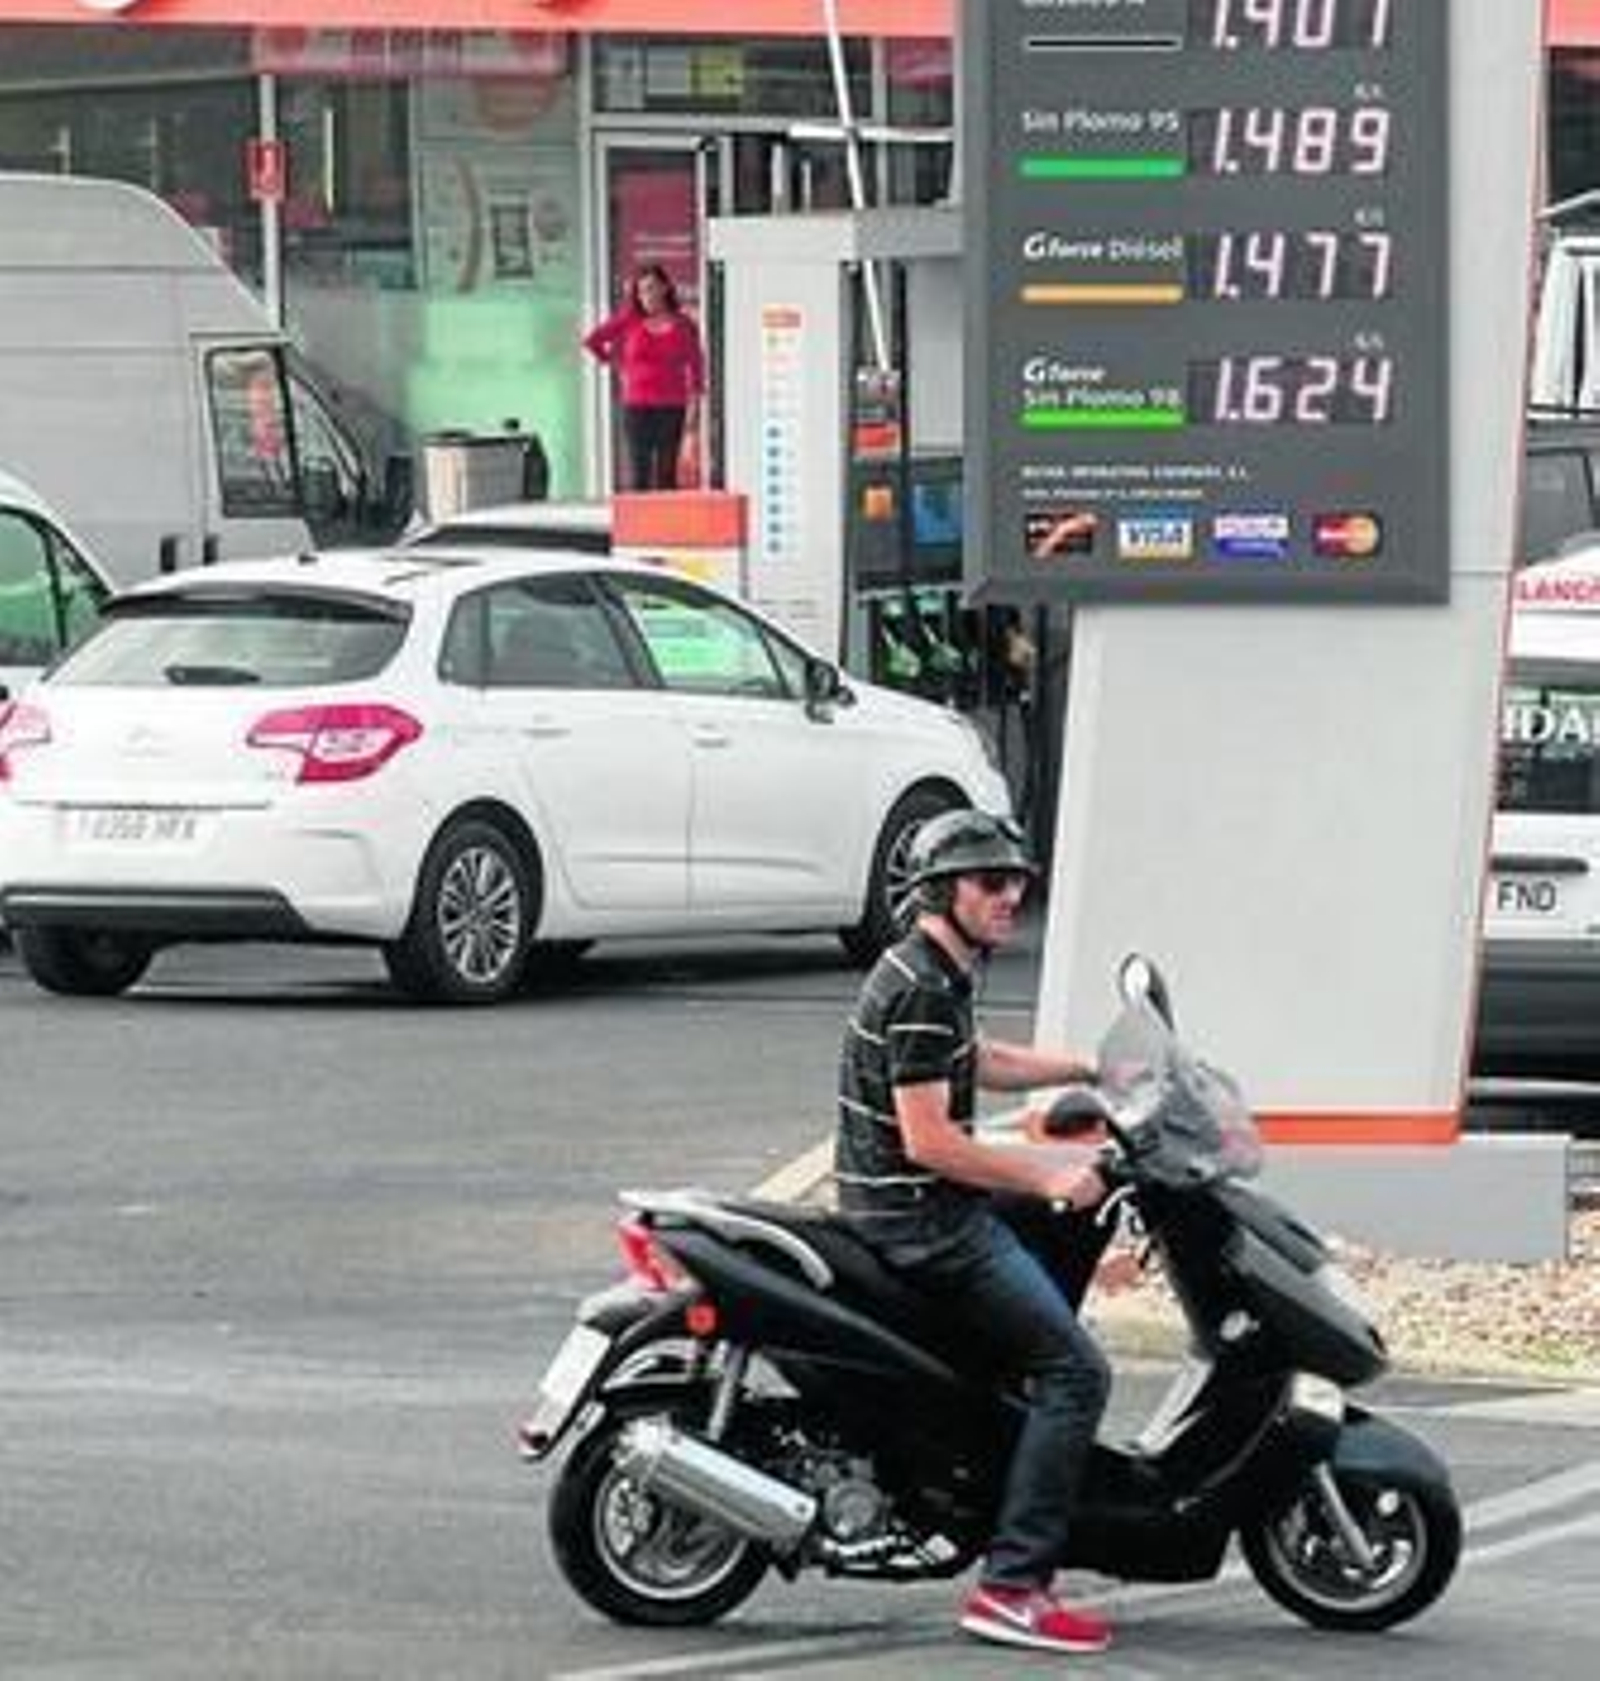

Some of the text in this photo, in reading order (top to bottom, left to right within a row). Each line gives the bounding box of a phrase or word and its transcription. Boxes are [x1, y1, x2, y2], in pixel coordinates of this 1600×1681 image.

[1023, 109, 1059, 132] Sin
[1214, 108, 1391, 172] 1.489
[1215, 232, 1391, 296] 1.477
[1215, 356, 1392, 420] 1.624
[1498, 881, 1556, 911] FND
